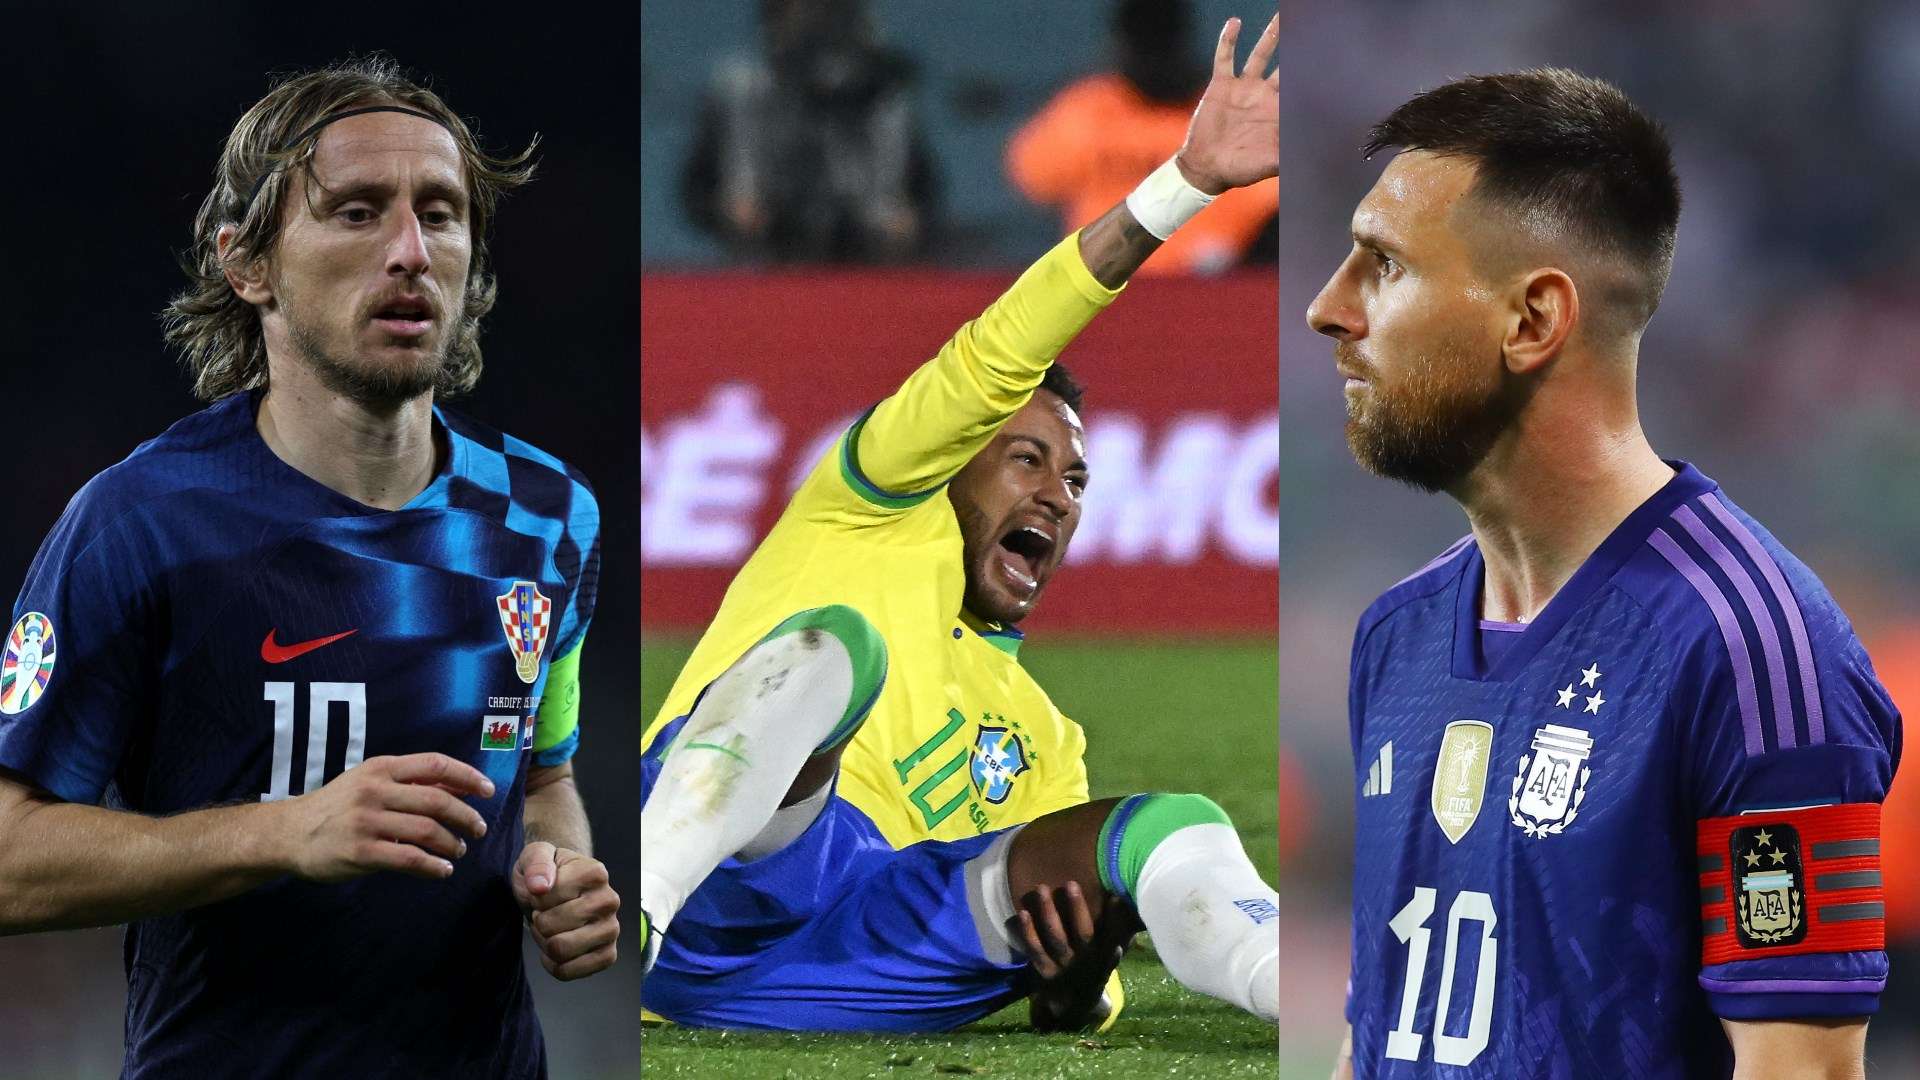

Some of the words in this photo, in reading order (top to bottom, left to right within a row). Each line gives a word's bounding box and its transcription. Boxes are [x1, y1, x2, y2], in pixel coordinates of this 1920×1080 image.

[261, 682, 366, 802] 10
[893, 708, 970, 831] 10
[984, 753, 1004, 773] CBF
[1528, 754, 1571, 806] AFA
[1753, 890, 1786, 922] AFA
[1385, 886, 1497, 1067] 10
